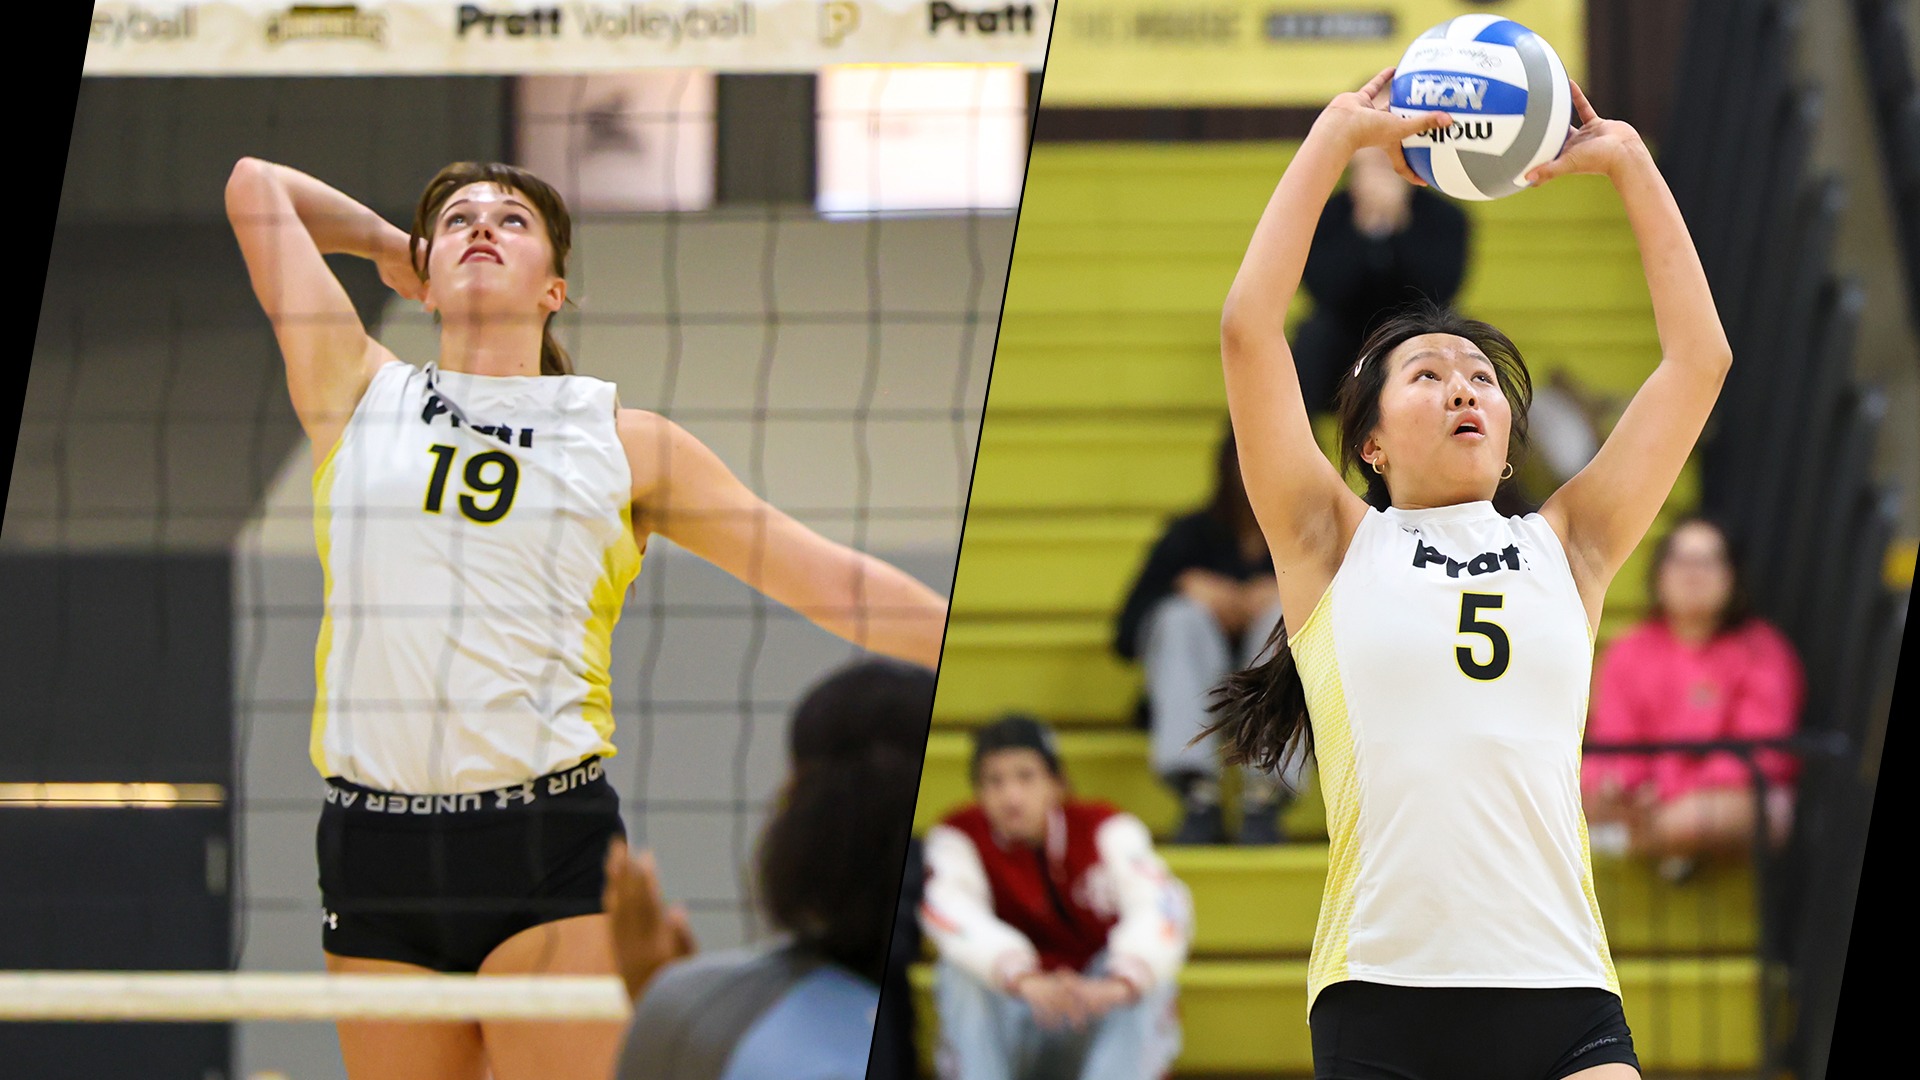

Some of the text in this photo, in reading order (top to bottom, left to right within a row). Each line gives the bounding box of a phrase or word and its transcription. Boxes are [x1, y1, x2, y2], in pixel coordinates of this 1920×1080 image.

[457, 3, 753, 46] Pratt Volleyball
[929, 2, 1034, 33] Pratt
[1411, 75, 1488, 110] NCAA
[422, 444, 520, 526] 19
[1412, 539, 1528, 578] Prat
[1454, 590, 1512, 683] 5
[365, 793, 482, 815] UNDER
